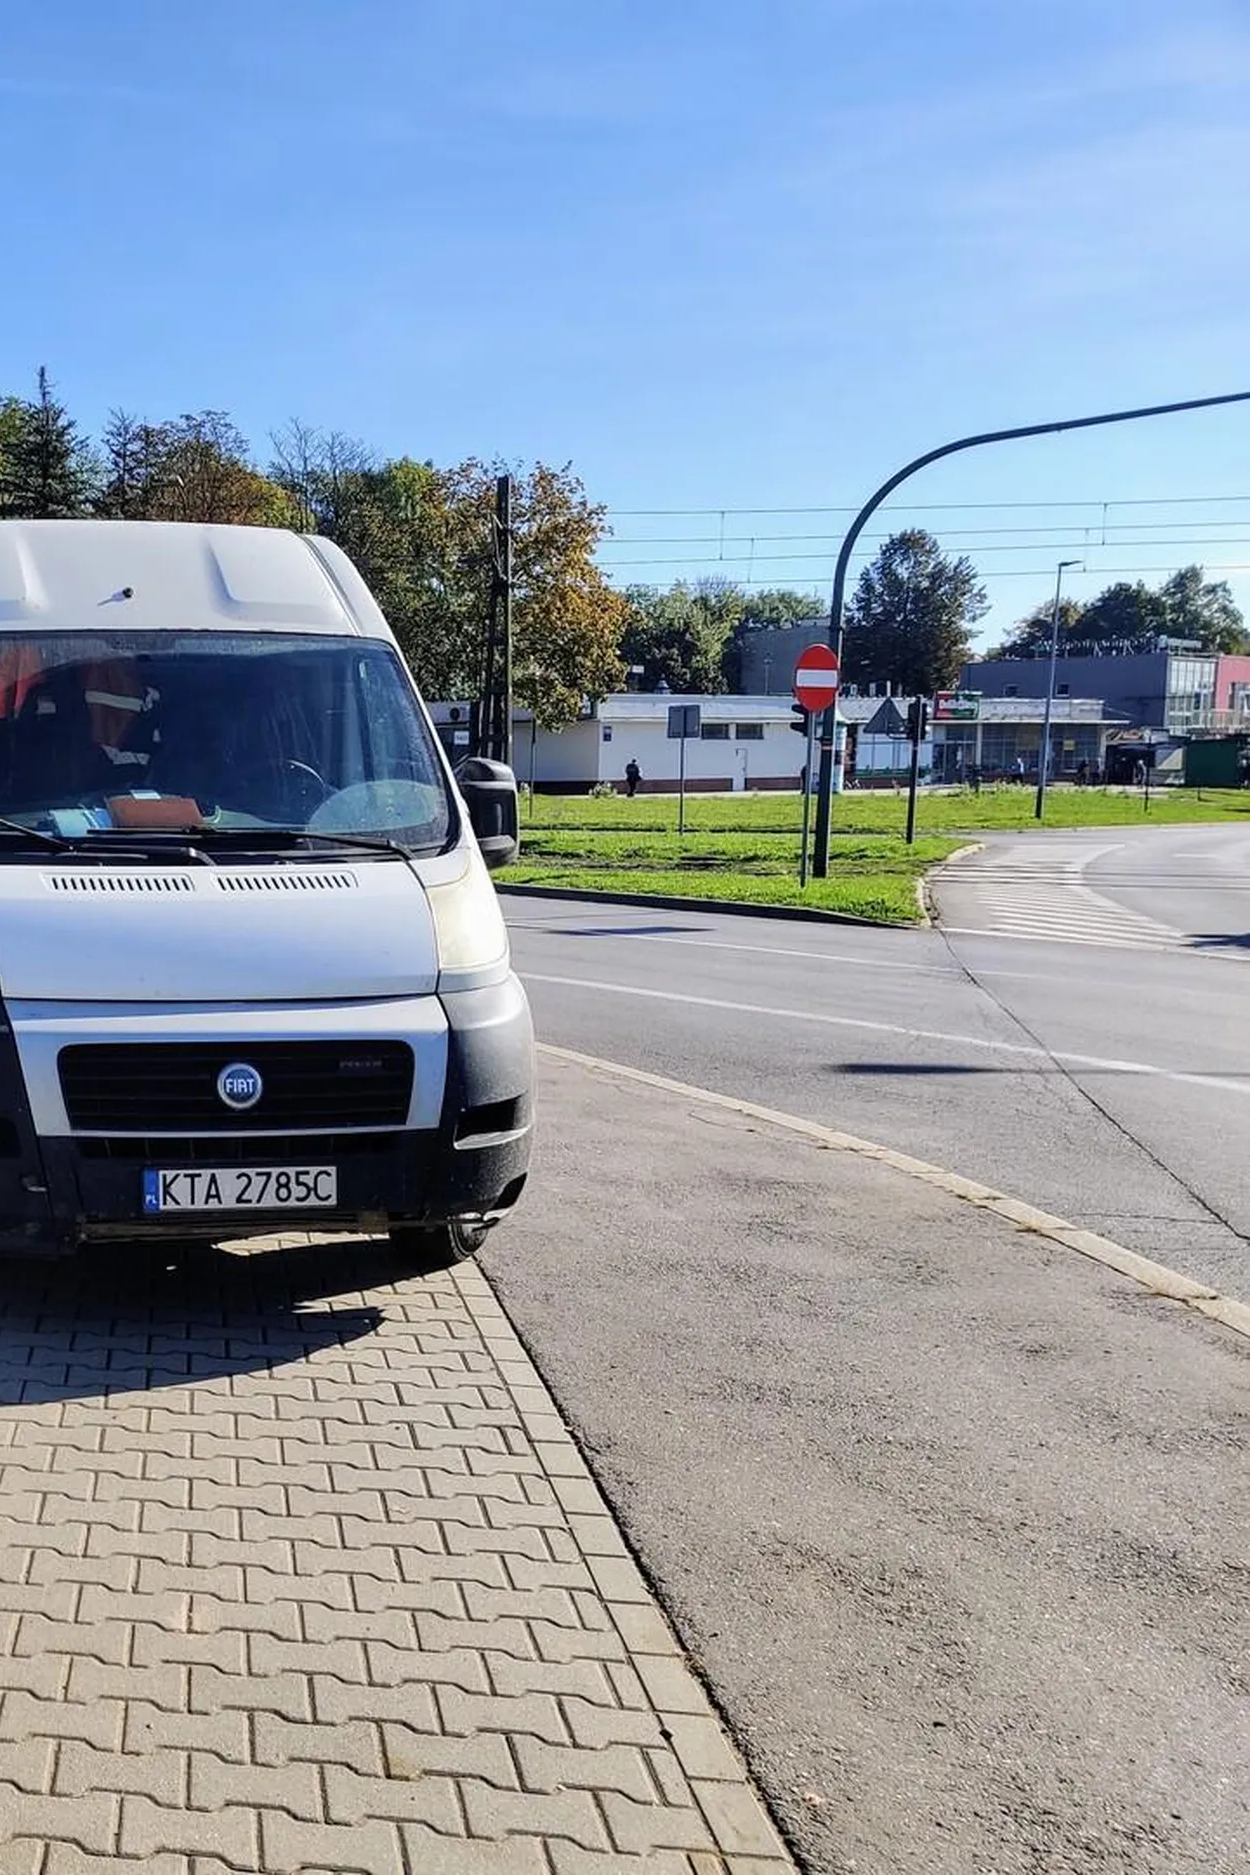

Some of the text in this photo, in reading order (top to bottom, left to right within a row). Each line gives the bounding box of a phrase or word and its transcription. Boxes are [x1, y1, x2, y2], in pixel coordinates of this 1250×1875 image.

[225, 1079, 254, 1093] FIAT
[161, 1170, 333, 1206] KTA 2785C
